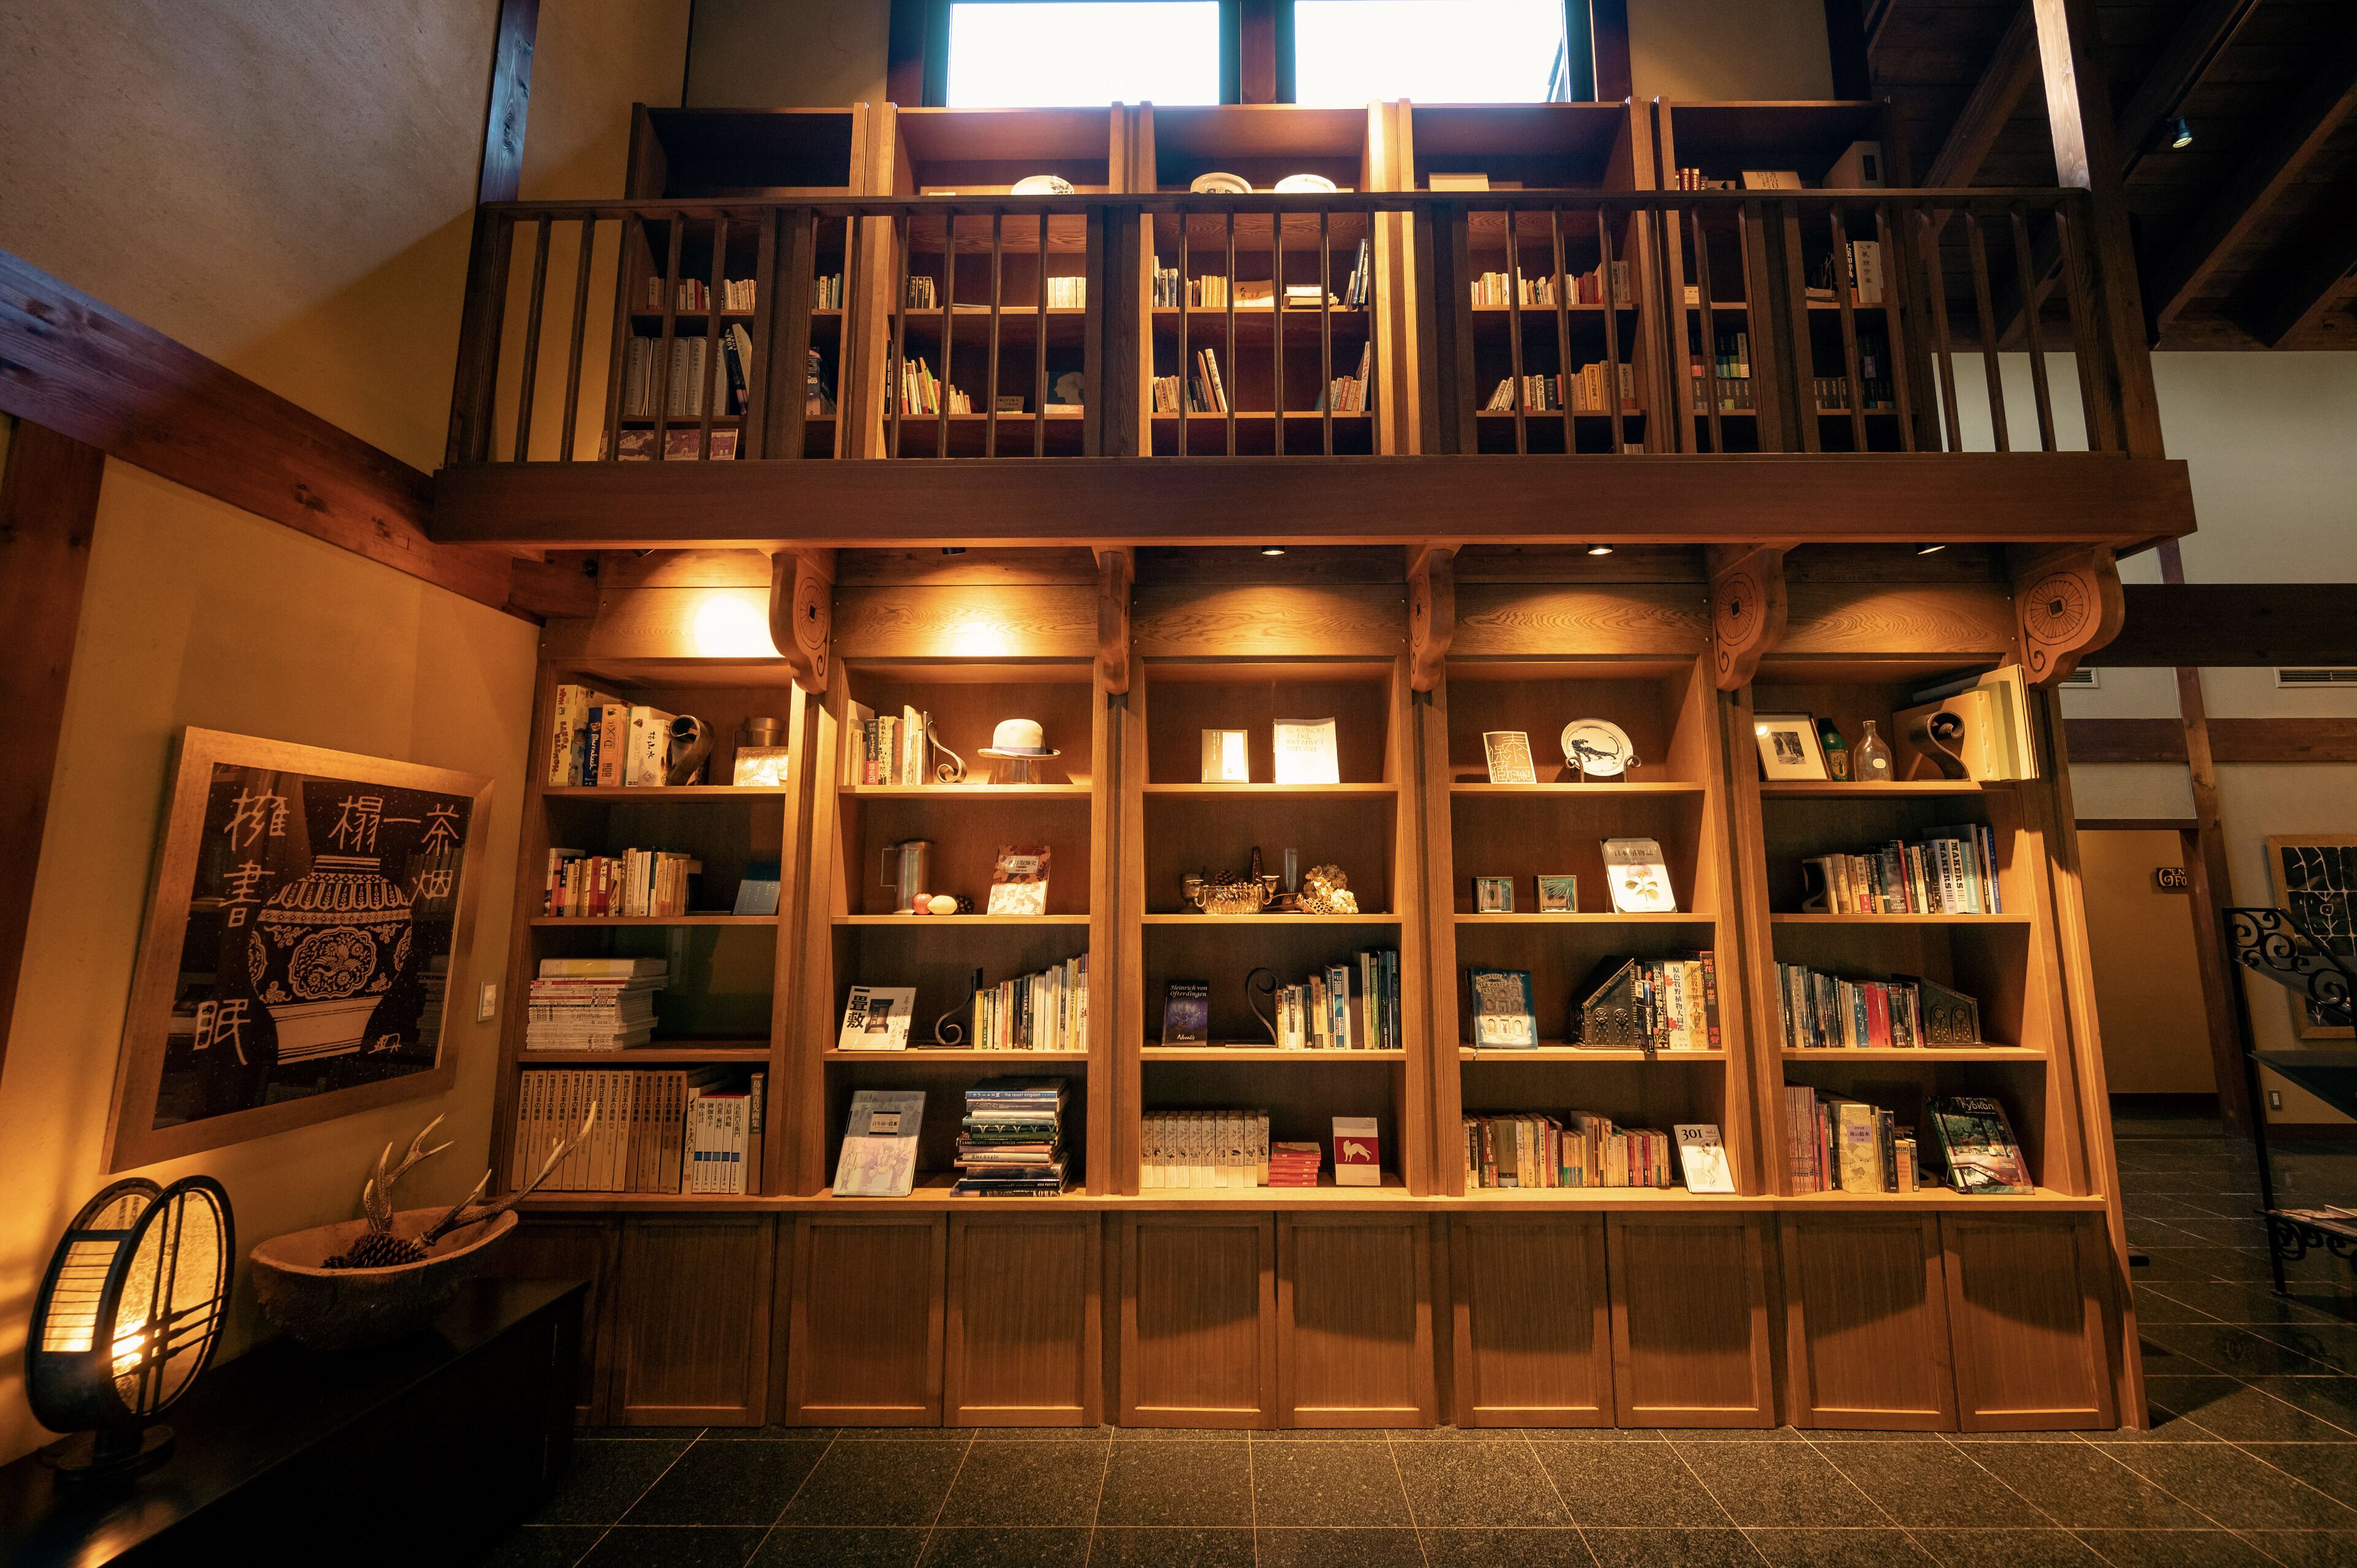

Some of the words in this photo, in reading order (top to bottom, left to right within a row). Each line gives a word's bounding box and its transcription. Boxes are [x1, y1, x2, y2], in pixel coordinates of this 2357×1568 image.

[558, 687, 567, 705] HABA
[552, 733, 561, 774] MONSTER
[560, 721, 570, 750] TORTE
[589, 734, 599, 770] Marrakech
[1939, 841, 1952, 889] MAKERS
[1951, 841, 1963, 889] MAKERS
[846, 988, 871, 1029] 一畳敷
[521, 1078, 530, 1121] 現代日本の美術
[533, 1078, 543, 1121] 現代日本の美術
[546, 1078, 556, 1121] 現代日本の美術
[559, 1078, 568, 1121] 現代日本の美術
[571, 1077, 581, 1120] 現代日本の美術
[597, 1078, 606, 1121] 現代日本の美術
[609, 1079, 619, 1121] 現代日本の美術
[621, 1078, 630, 1122] 現代日本の美術
[633, 1076, 643, 1123] 原色日本の美術
[644, 1076, 654, 1123] 原色日本の美術
[655, 1076, 664, 1122] 原色日本の美術
[665, 1076, 674, 1122] 原色日本の美術
[1961, 1102, 1994, 1111] ryokan
[1681, 1129, 1703, 1141] 301
